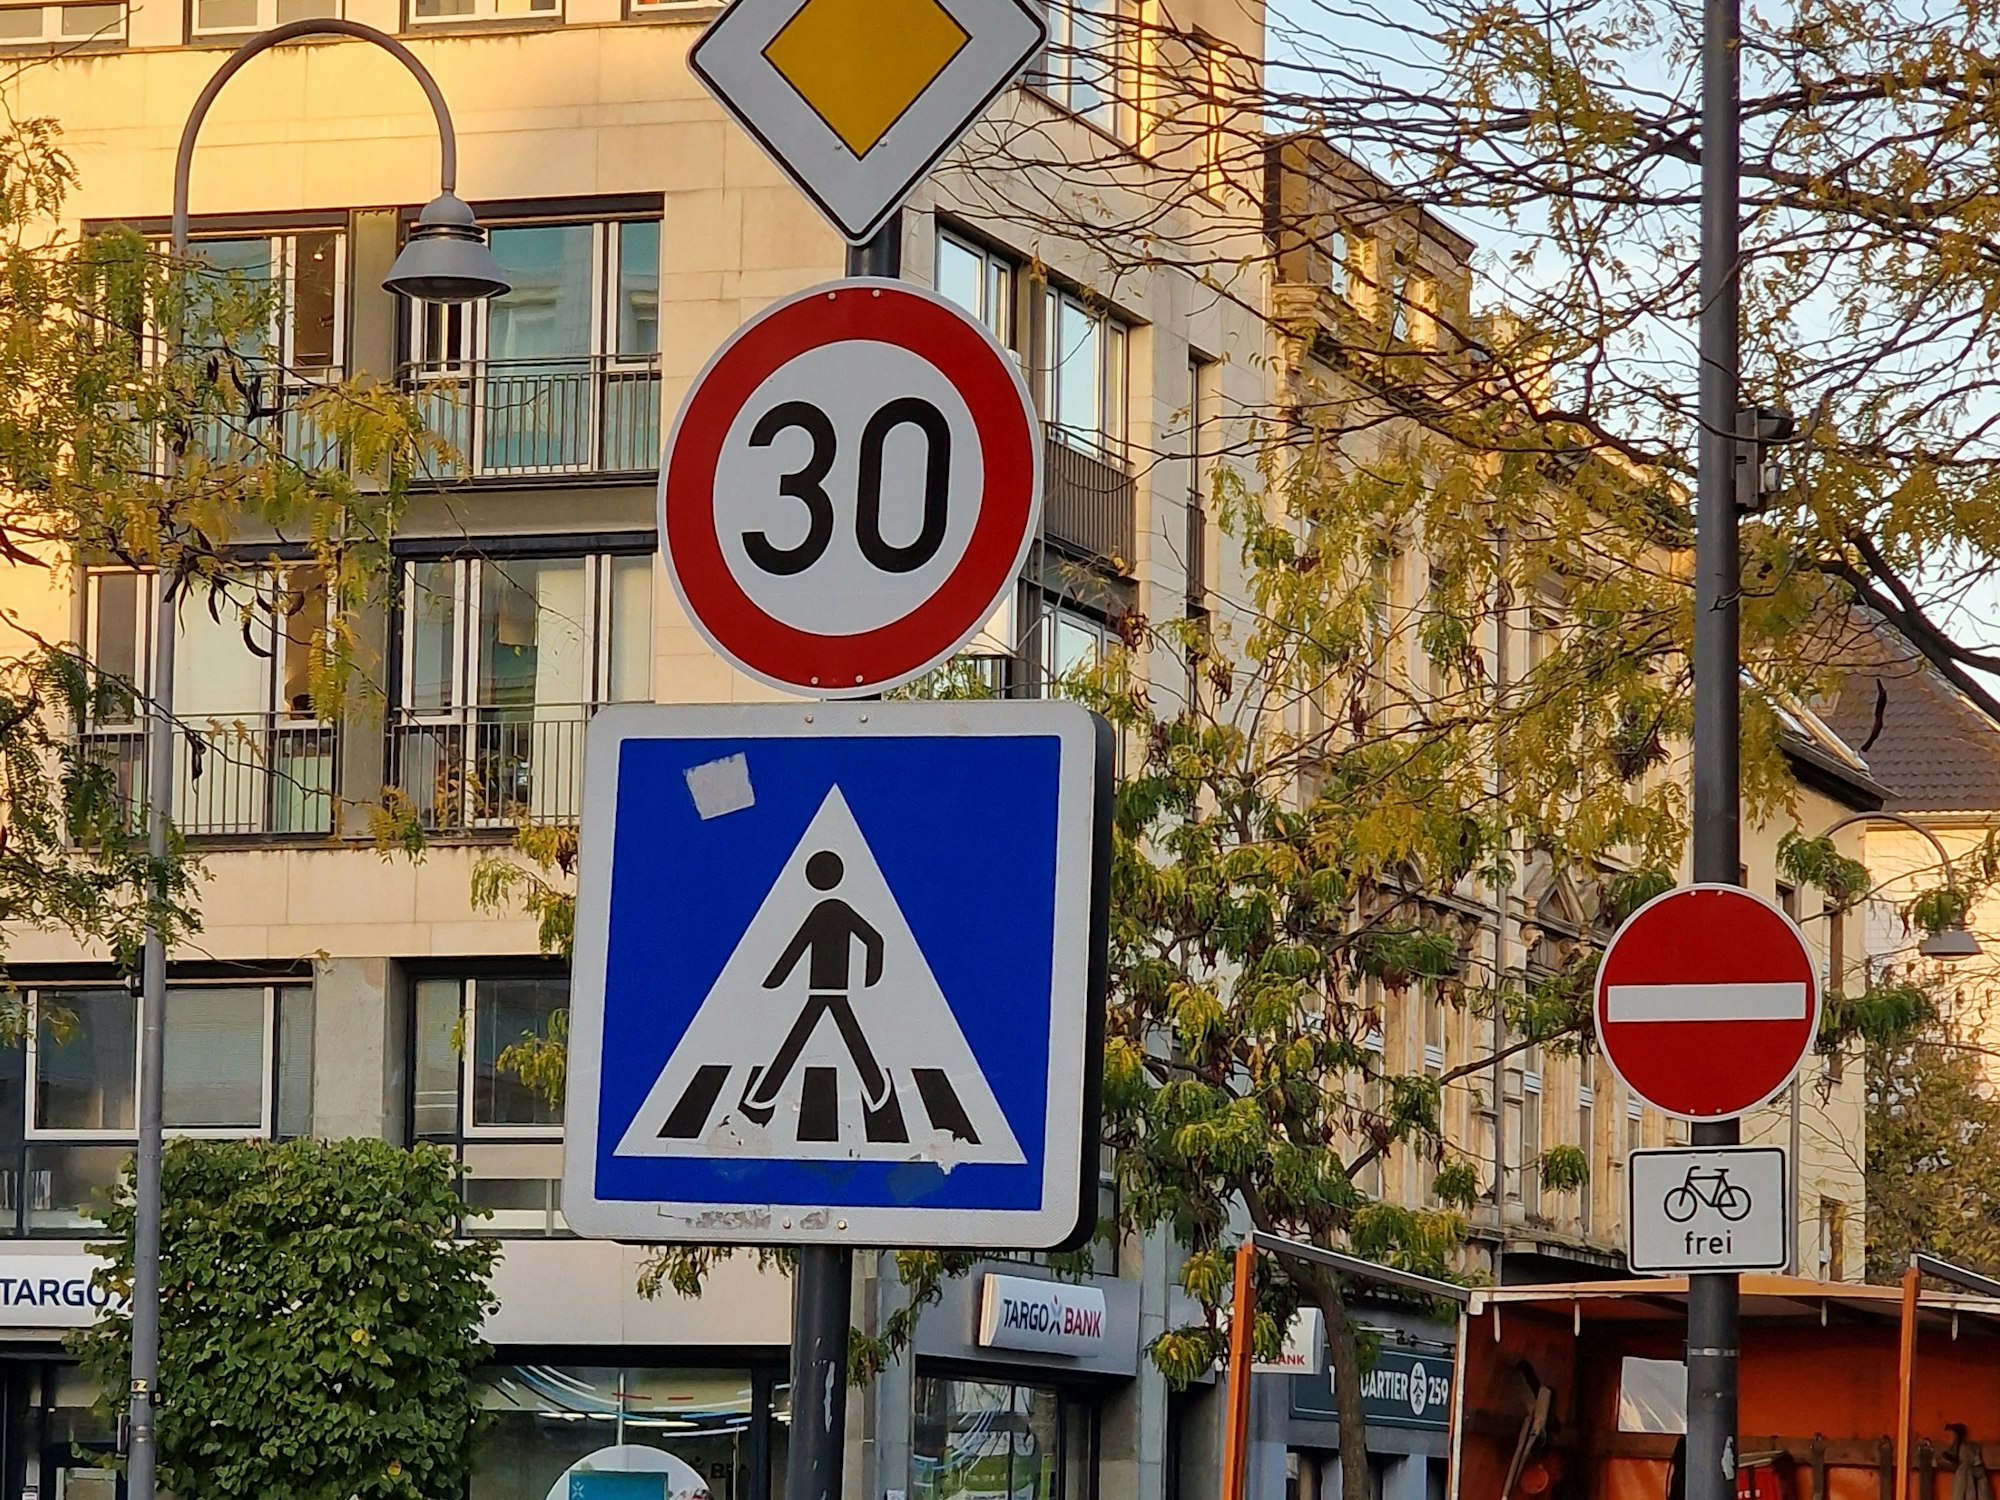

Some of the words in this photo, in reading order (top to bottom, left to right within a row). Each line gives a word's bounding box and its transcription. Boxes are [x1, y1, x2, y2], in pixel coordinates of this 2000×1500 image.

[742, 397, 951, 576] 30
[1685, 1229, 1731, 1255] frei
[0, 1279, 110, 1306] TARGO
[1003, 1298, 1049, 1332] TARGO
[1064, 1307, 1101, 1338] BANK
[1427, 1376, 1449, 1406] 259
